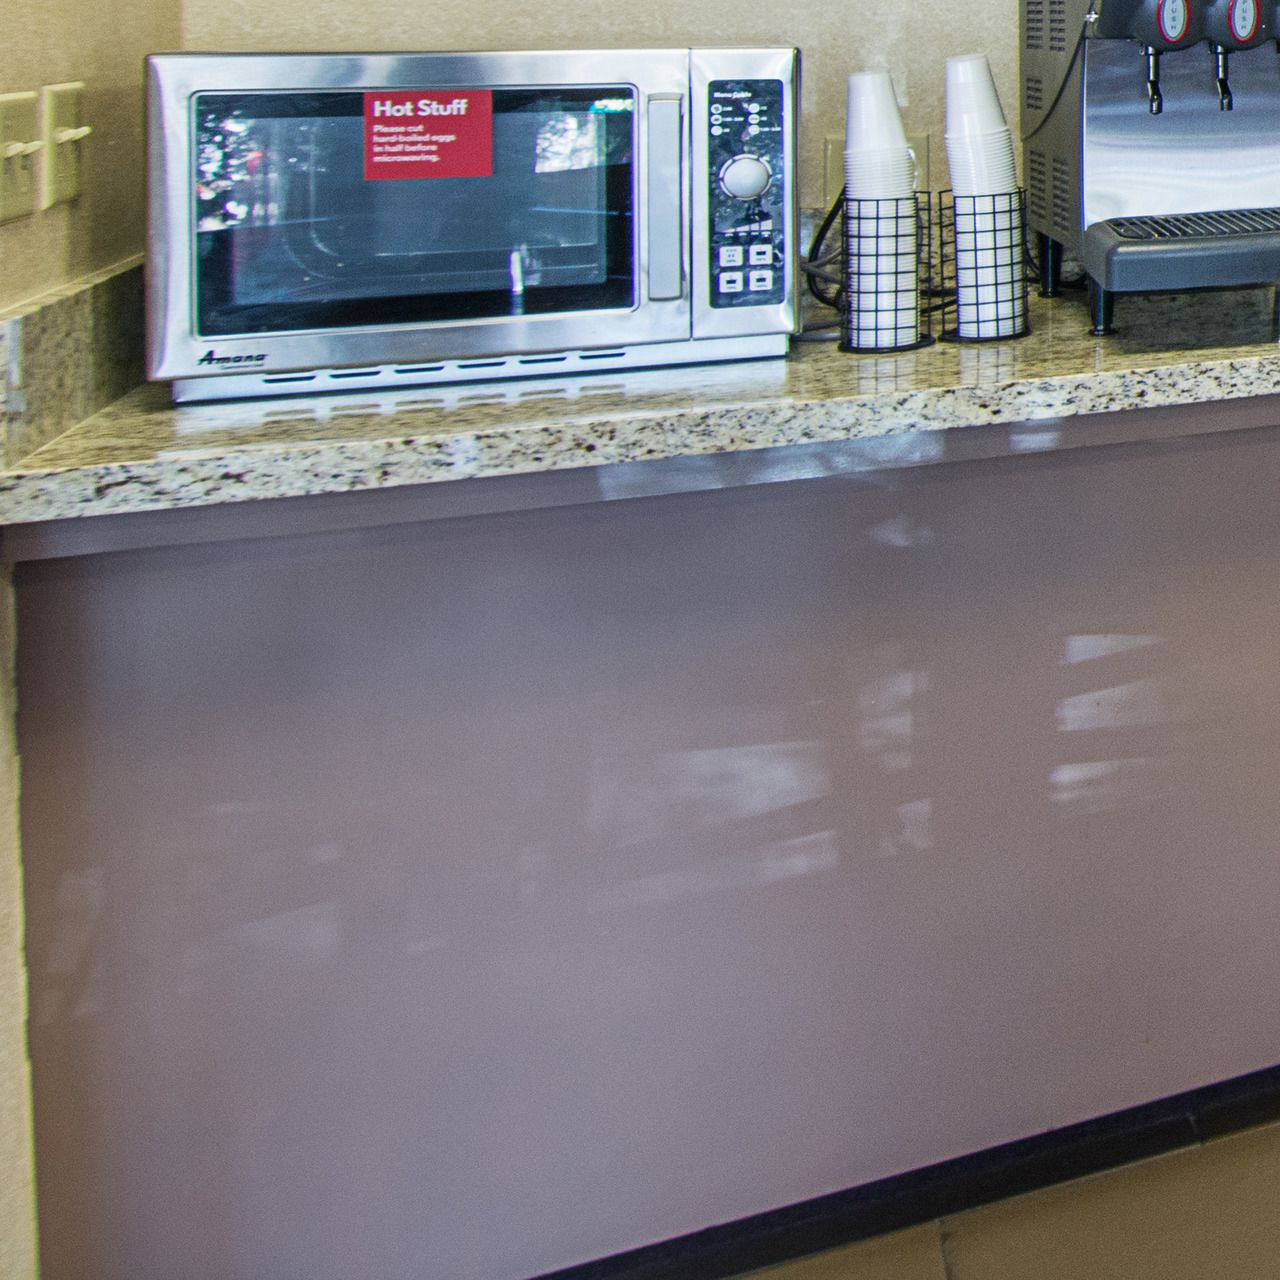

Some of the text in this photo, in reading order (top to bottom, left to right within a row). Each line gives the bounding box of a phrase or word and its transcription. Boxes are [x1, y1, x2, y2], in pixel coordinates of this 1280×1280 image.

[1170, 0, 1178, 30] PUSH
[1240, 0, 1248, 30] PUSH
[373, 98, 469, 117] Hot Stuff
[372, 124, 424, 133] Please cut
[431, 134, 457, 143] eggs
[373, 143, 438, 152] in half before
[197, 349, 269, 366] Amana
